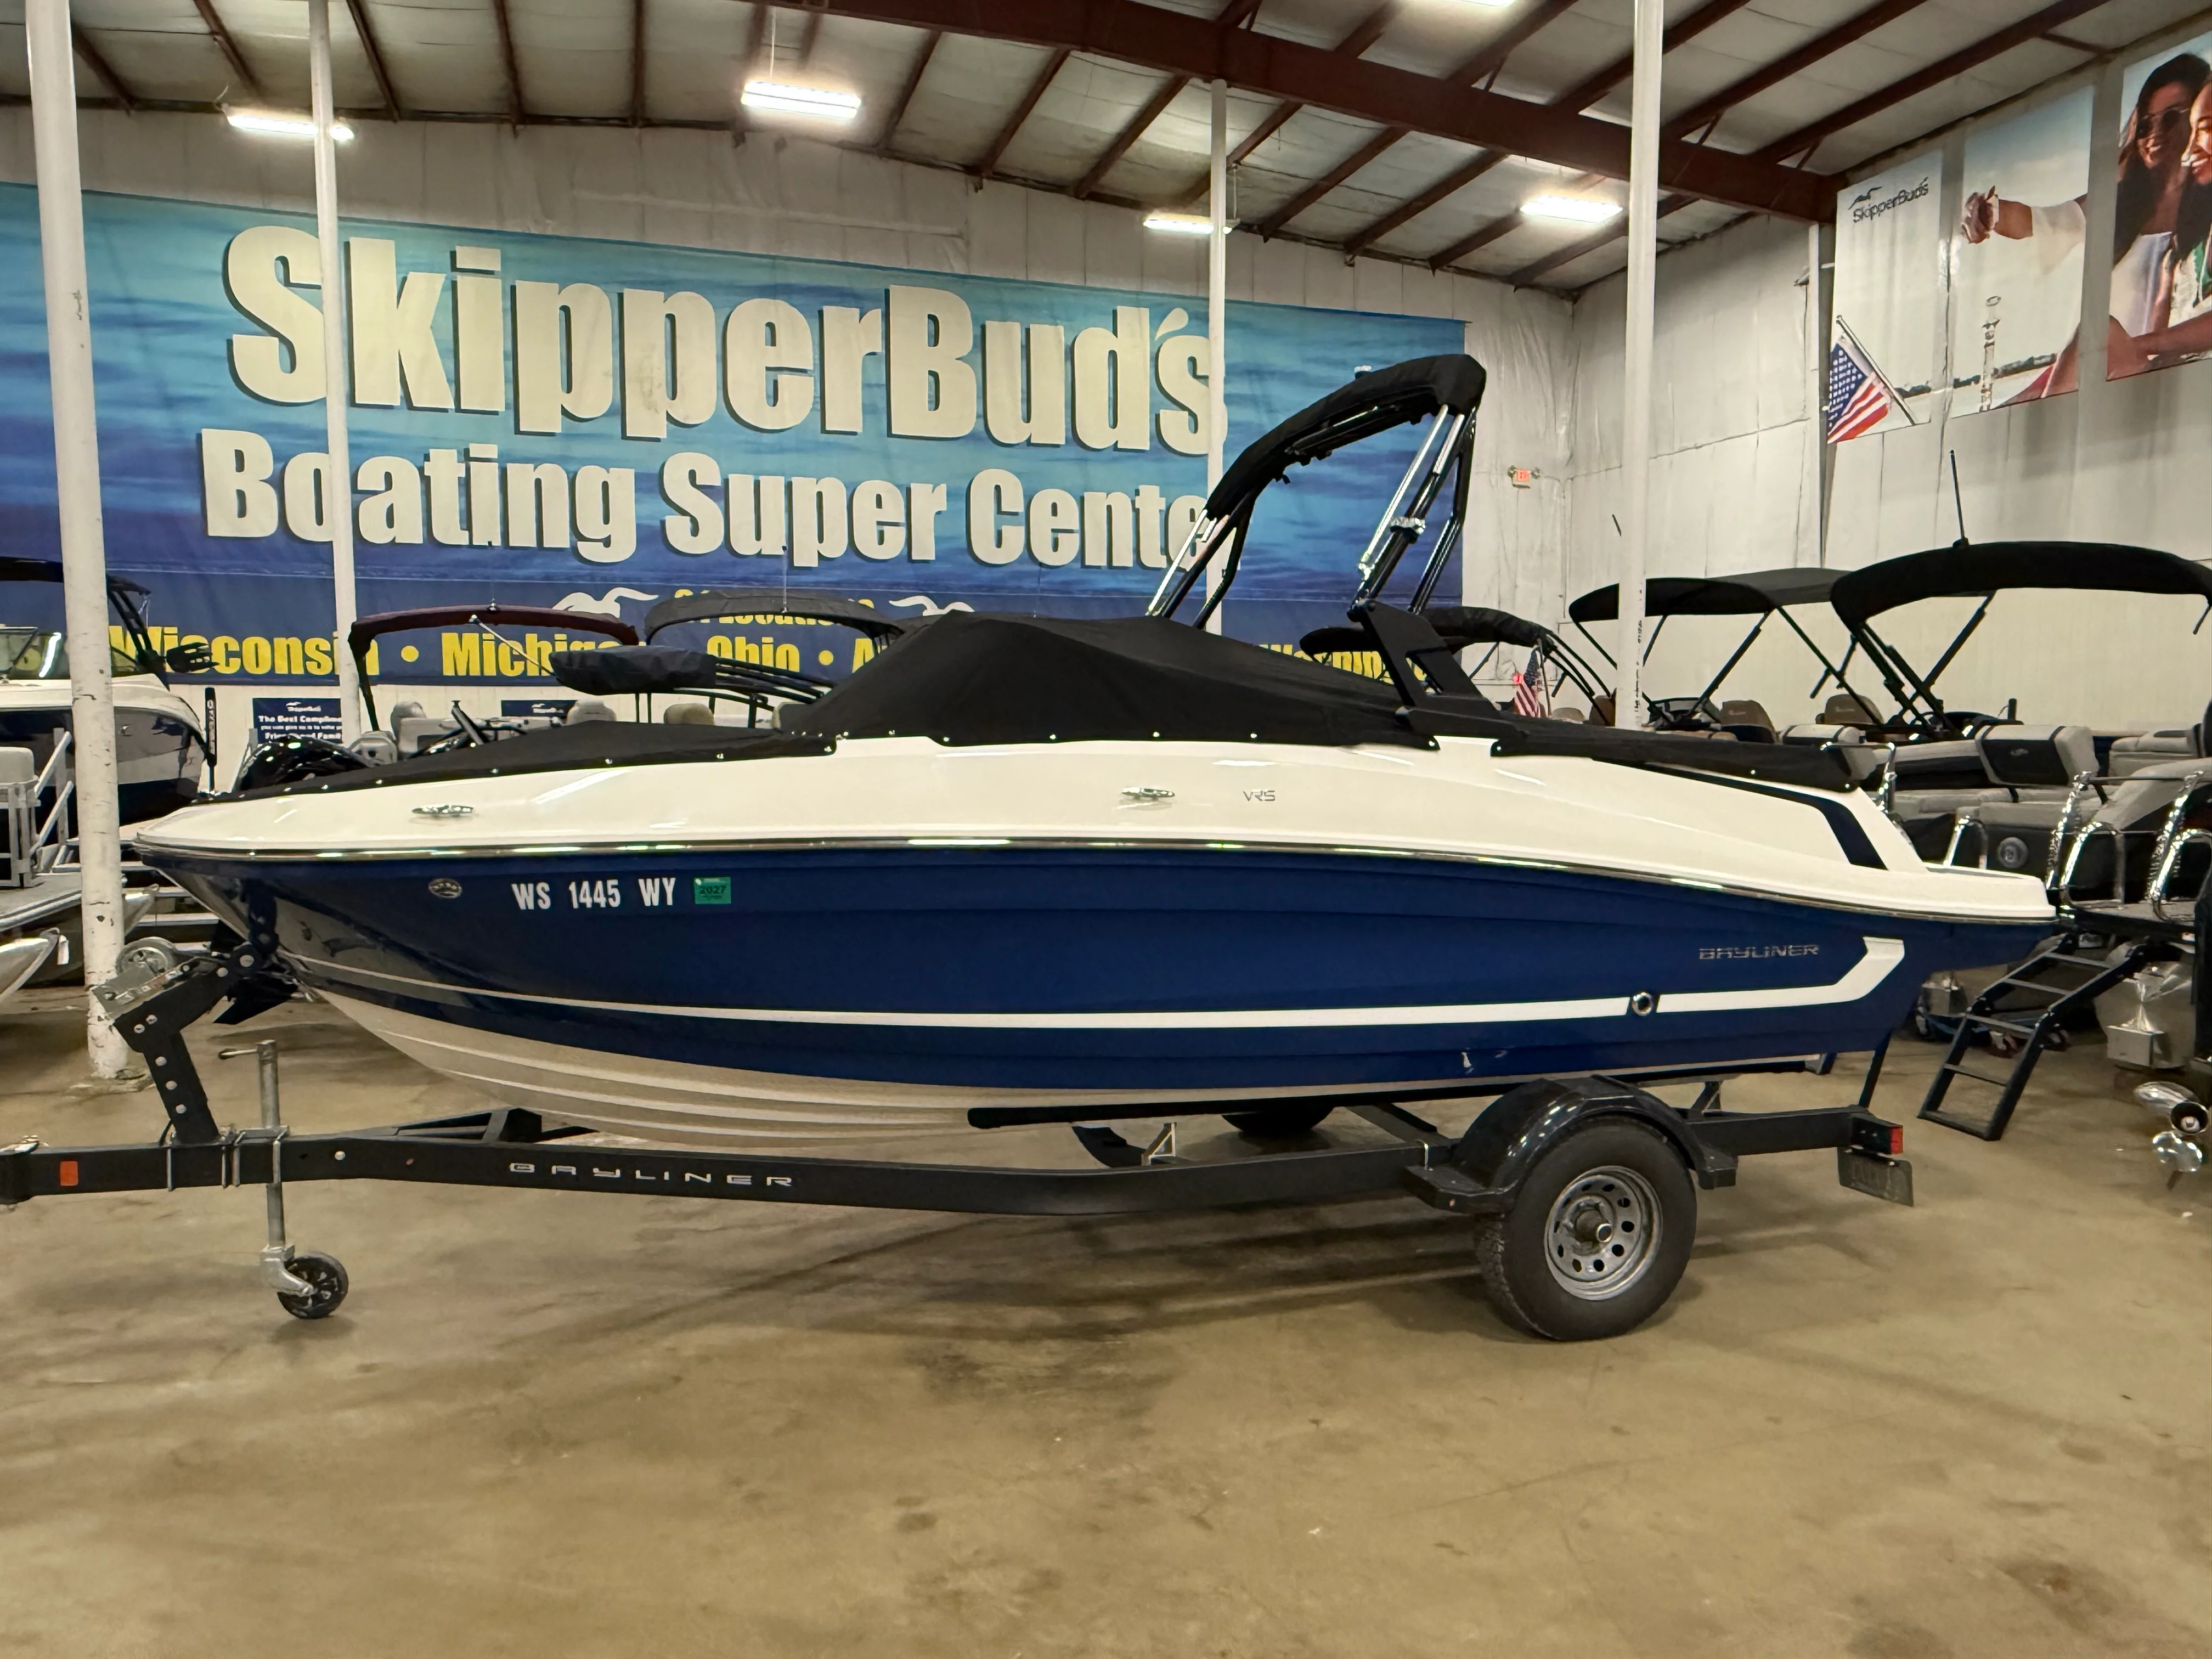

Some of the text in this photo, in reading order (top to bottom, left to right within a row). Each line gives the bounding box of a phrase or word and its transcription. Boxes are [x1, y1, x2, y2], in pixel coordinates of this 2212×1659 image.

[226, 225, 1228, 456] SkipperBud's
[199, 428, 1214, 572] Boating Super Cente
[1243, 790, 1276, 802] VRS
[511, 877, 676, 910] WS 1445 WY
[699, 885, 726, 894] 2027
[1699, 944, 1819, 960] BAYLINER
[510, 1163, 792, 1187] BAYLINER
